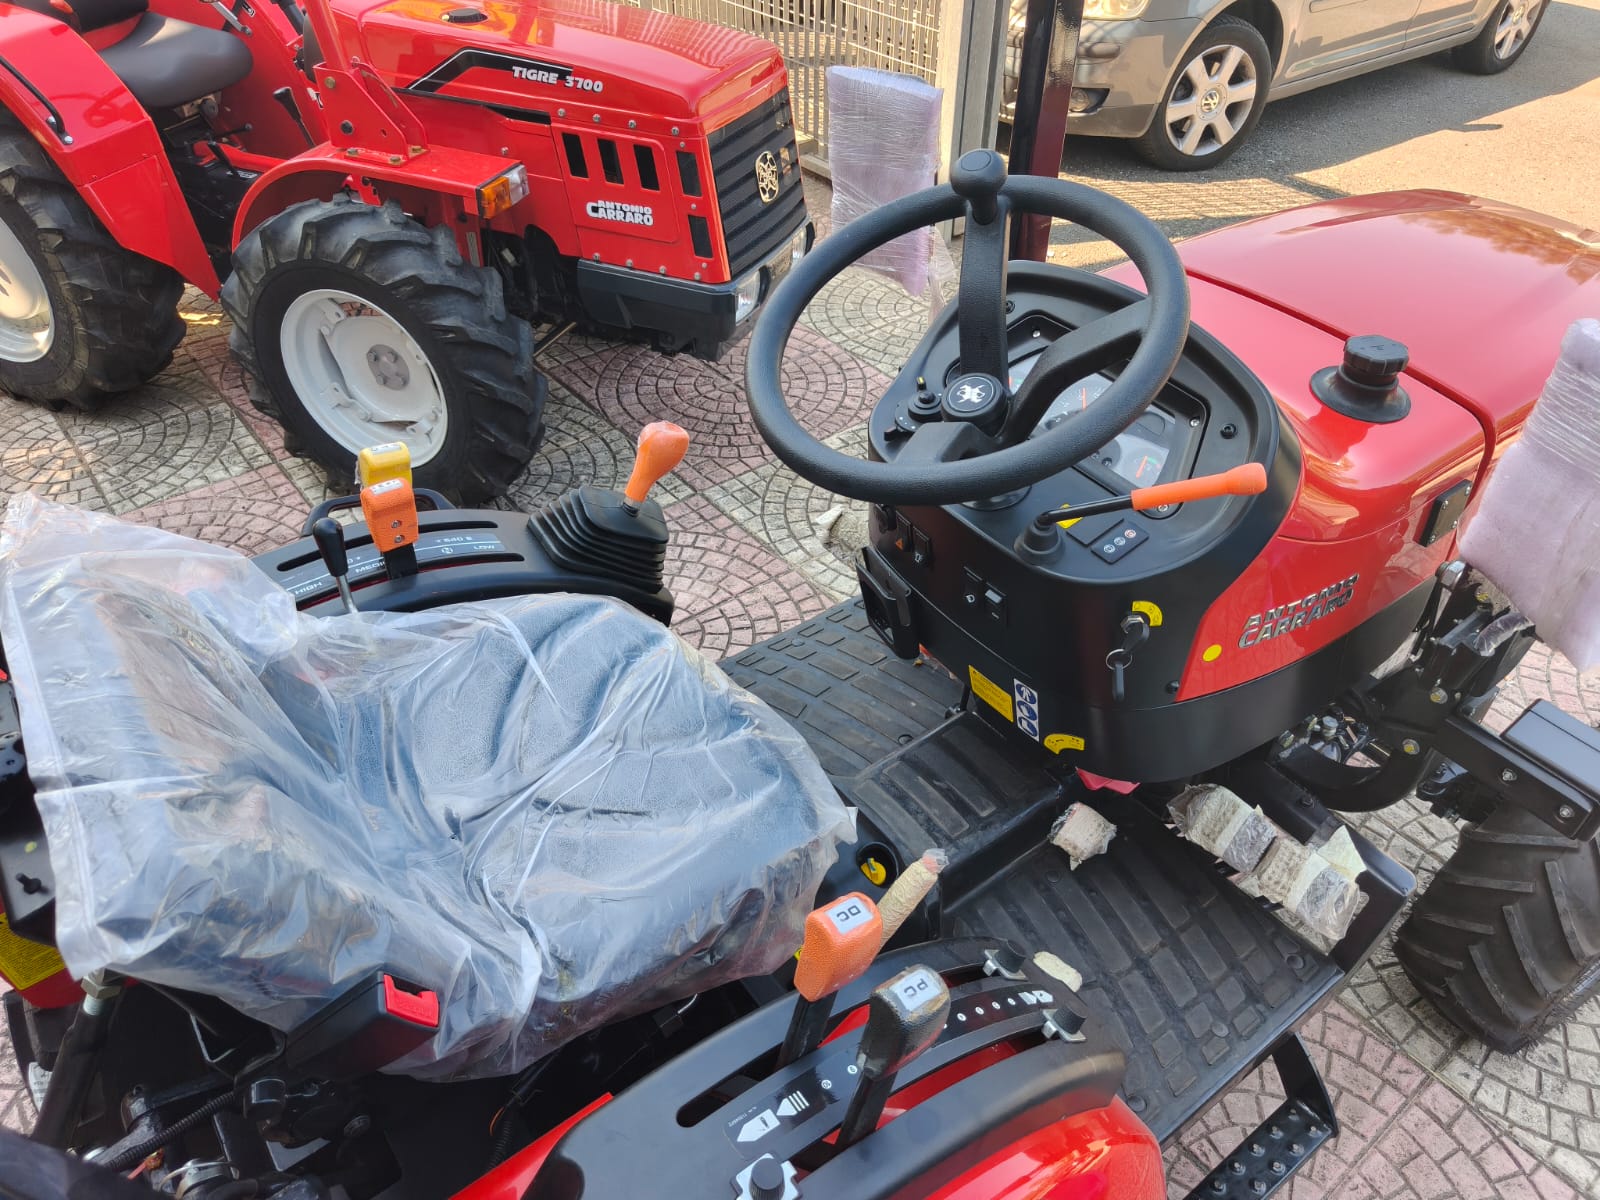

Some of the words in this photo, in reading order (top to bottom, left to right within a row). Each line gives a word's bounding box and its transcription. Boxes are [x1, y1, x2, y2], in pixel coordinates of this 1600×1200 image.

[512, 66, 559, 84] TIGRE
[565, 75, 604, 93] 3700
[586, 201, 654, 226] CARRARO
[597, 200, 653, 215] ANTONIO
[1237, 587, 1355, 649] CARRARO
[836, 905, 861, 922] DC
[903, 978, 929, 998] PC
